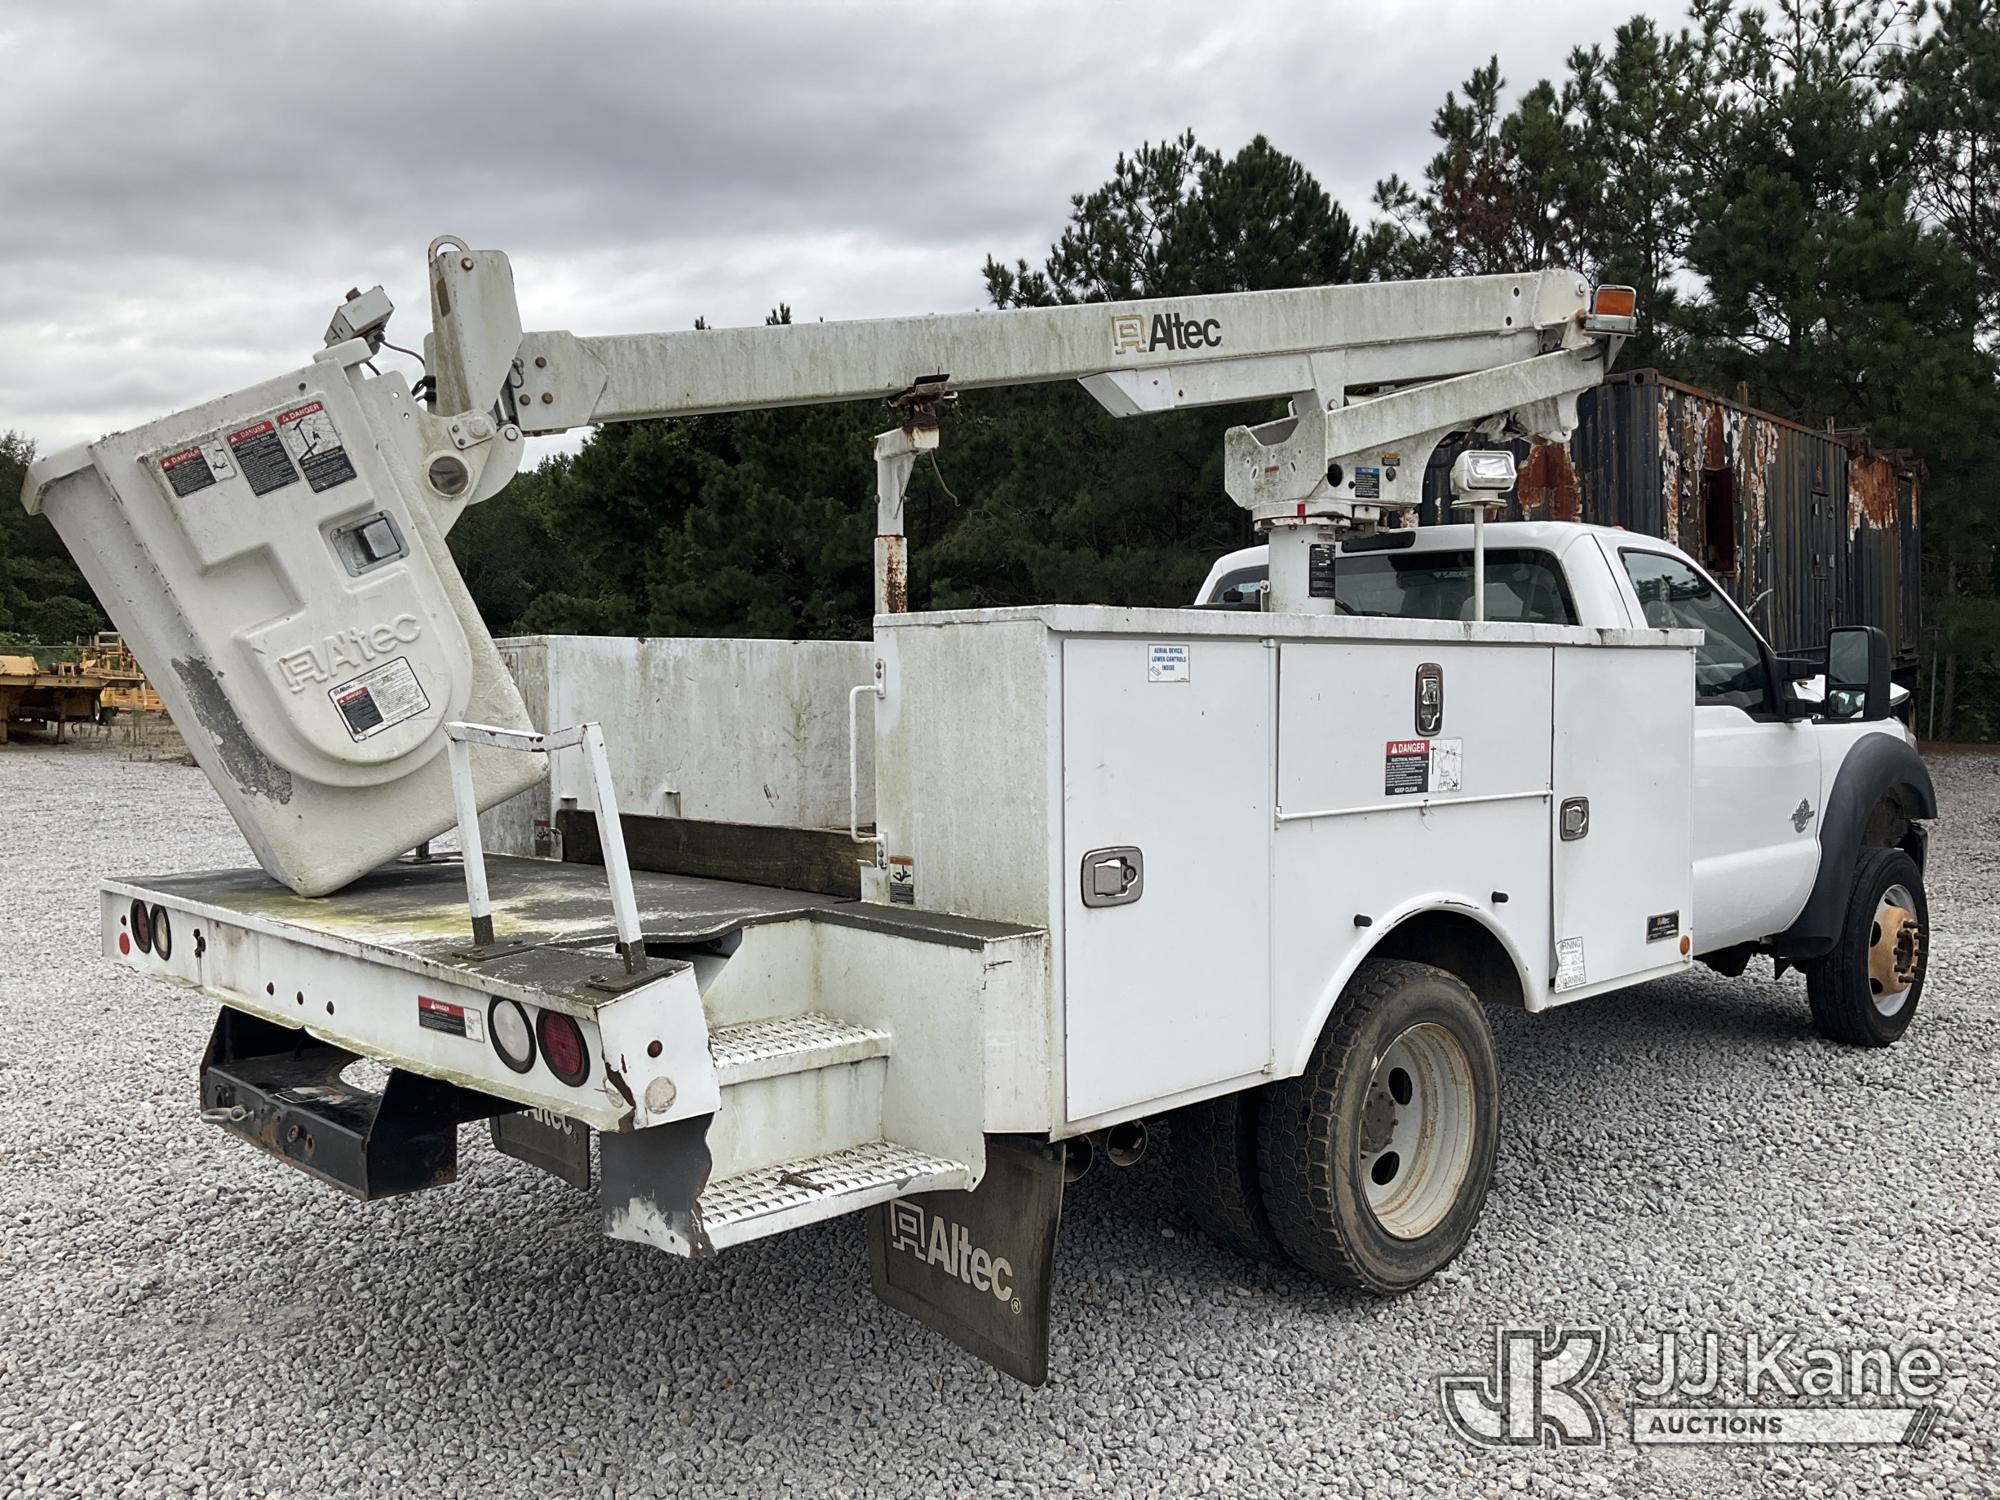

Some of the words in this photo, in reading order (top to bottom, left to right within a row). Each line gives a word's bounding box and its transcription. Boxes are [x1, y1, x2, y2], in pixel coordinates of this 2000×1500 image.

[1149, 313, 1222, 352] Altec
[289, 402, 320, 420] DANGER
[323, 613, 422, 678] Altec
[1398, 742, 1425, 753] DANGER
[927, 1215, 1013, 1301] Altec
